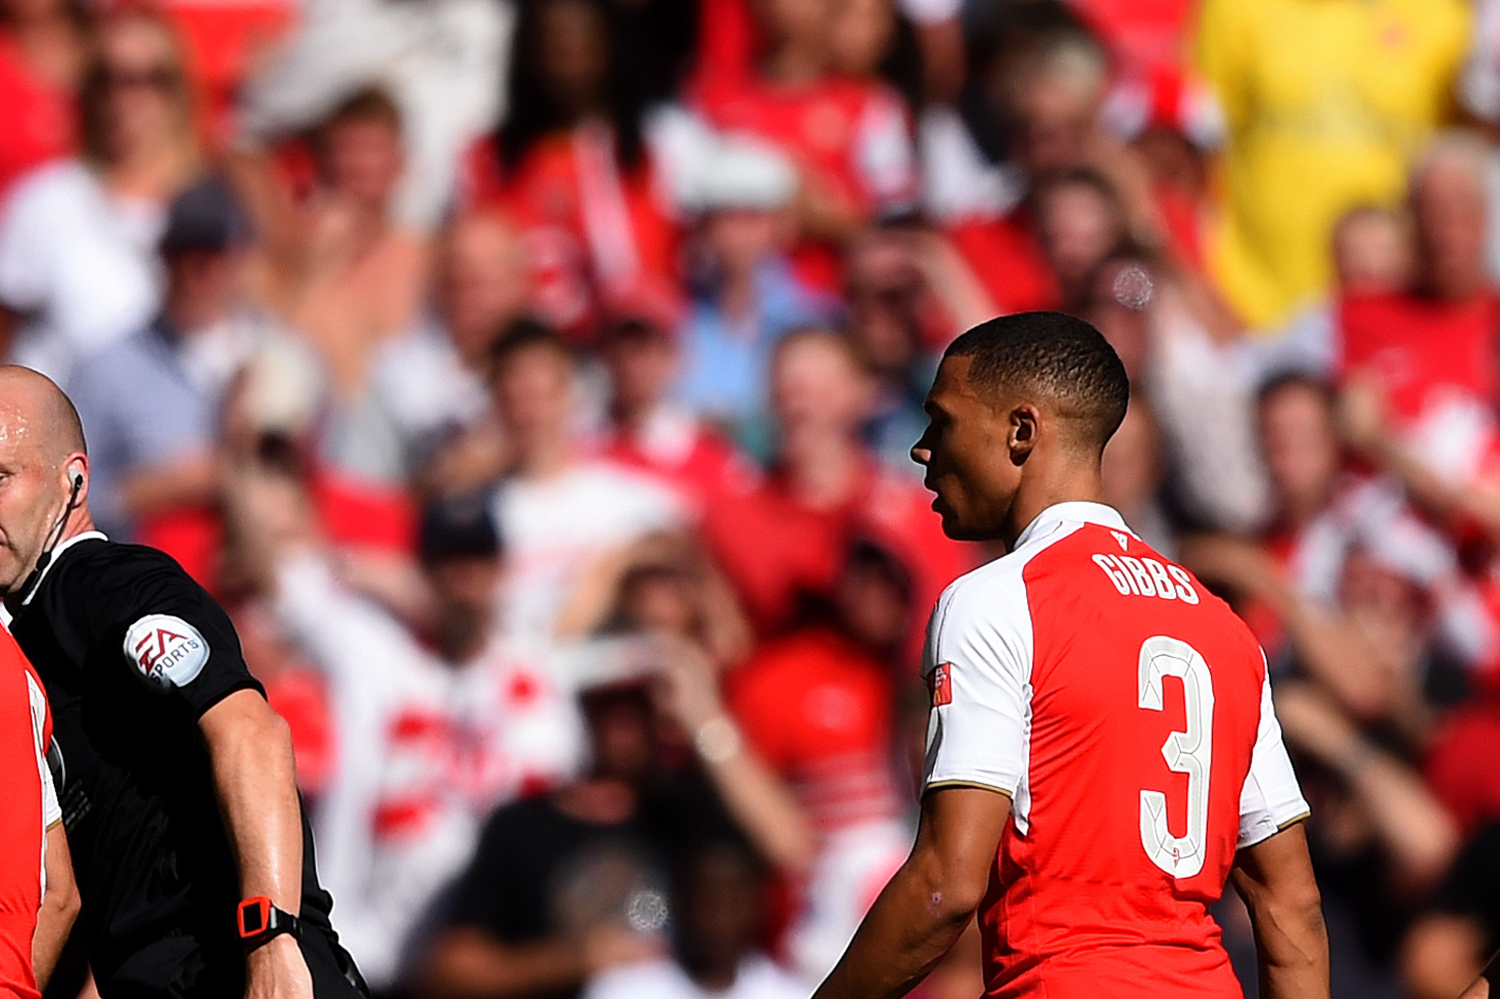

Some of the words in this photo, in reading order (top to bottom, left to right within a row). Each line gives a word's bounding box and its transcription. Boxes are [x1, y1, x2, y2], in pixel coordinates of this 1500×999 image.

[1092, 554, 1199, 604] GIBBS
[135, 628, 188, 676] EA
[150, 640, 199, 685] SPORTS
[1138, 635, 1214, 879] 3
